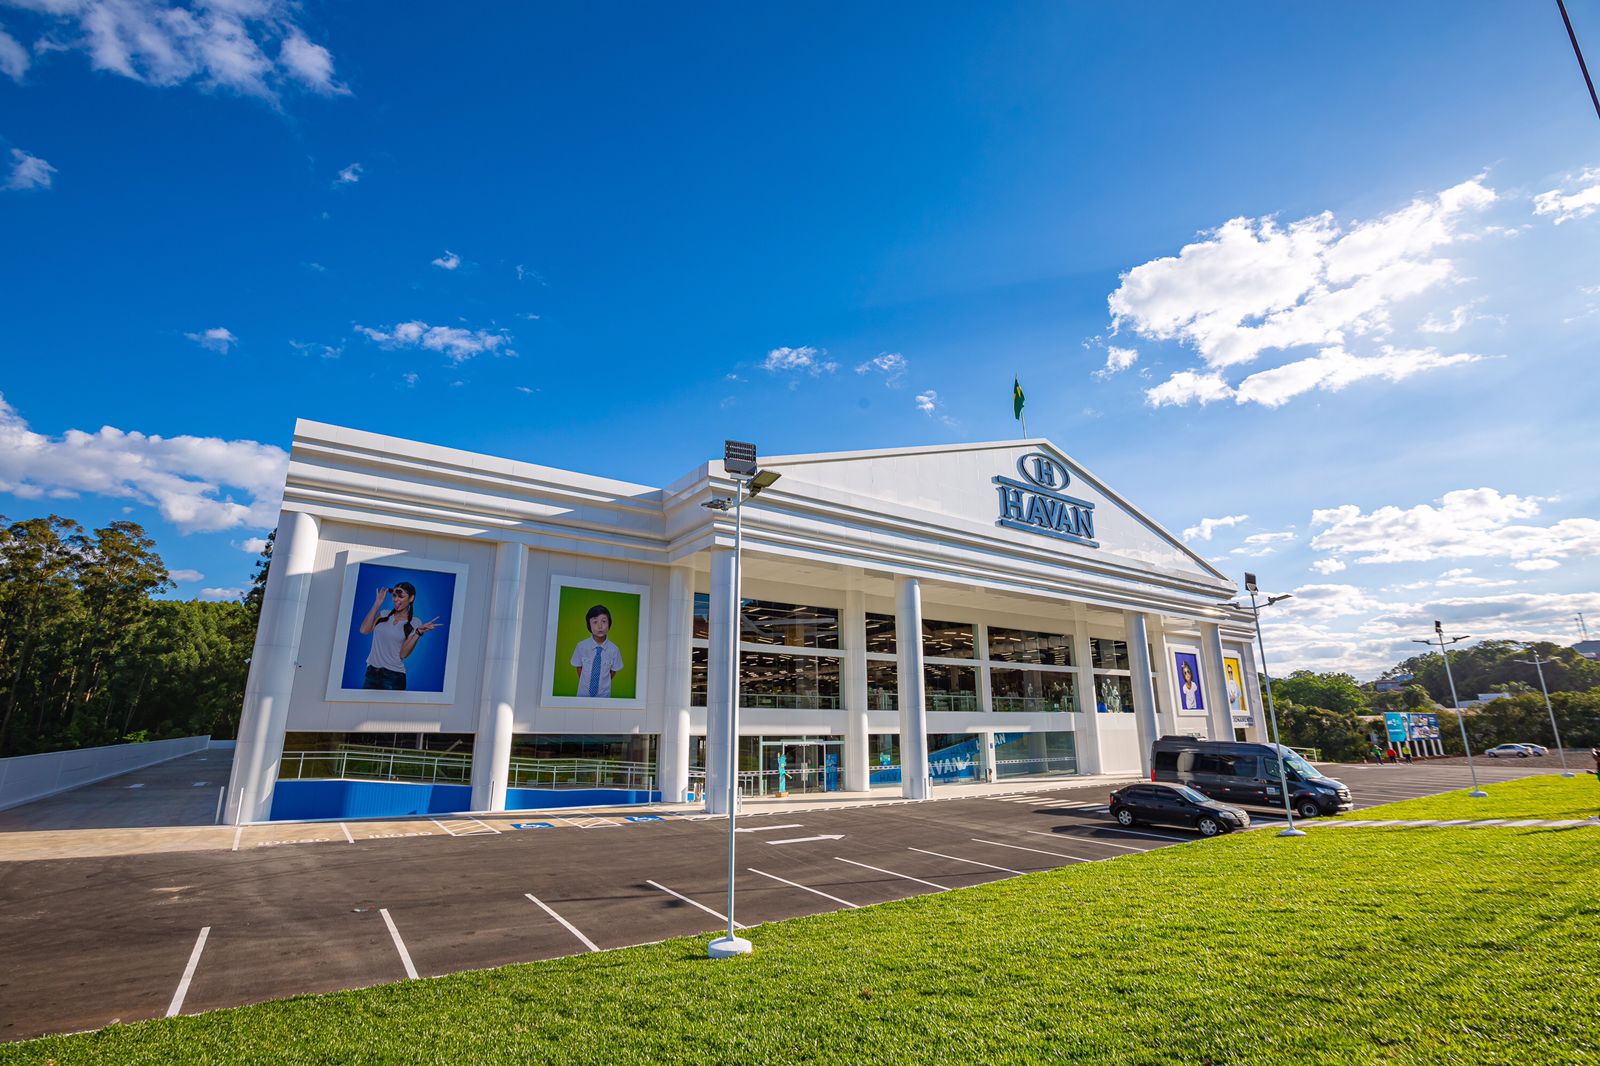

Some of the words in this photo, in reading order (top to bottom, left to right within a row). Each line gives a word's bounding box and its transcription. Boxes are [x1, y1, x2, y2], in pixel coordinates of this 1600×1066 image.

[1032, 458, 1056, 486] H
[996, 485, 1095, 539] HAVAN
[928, 756, 961, 777] AVAN
